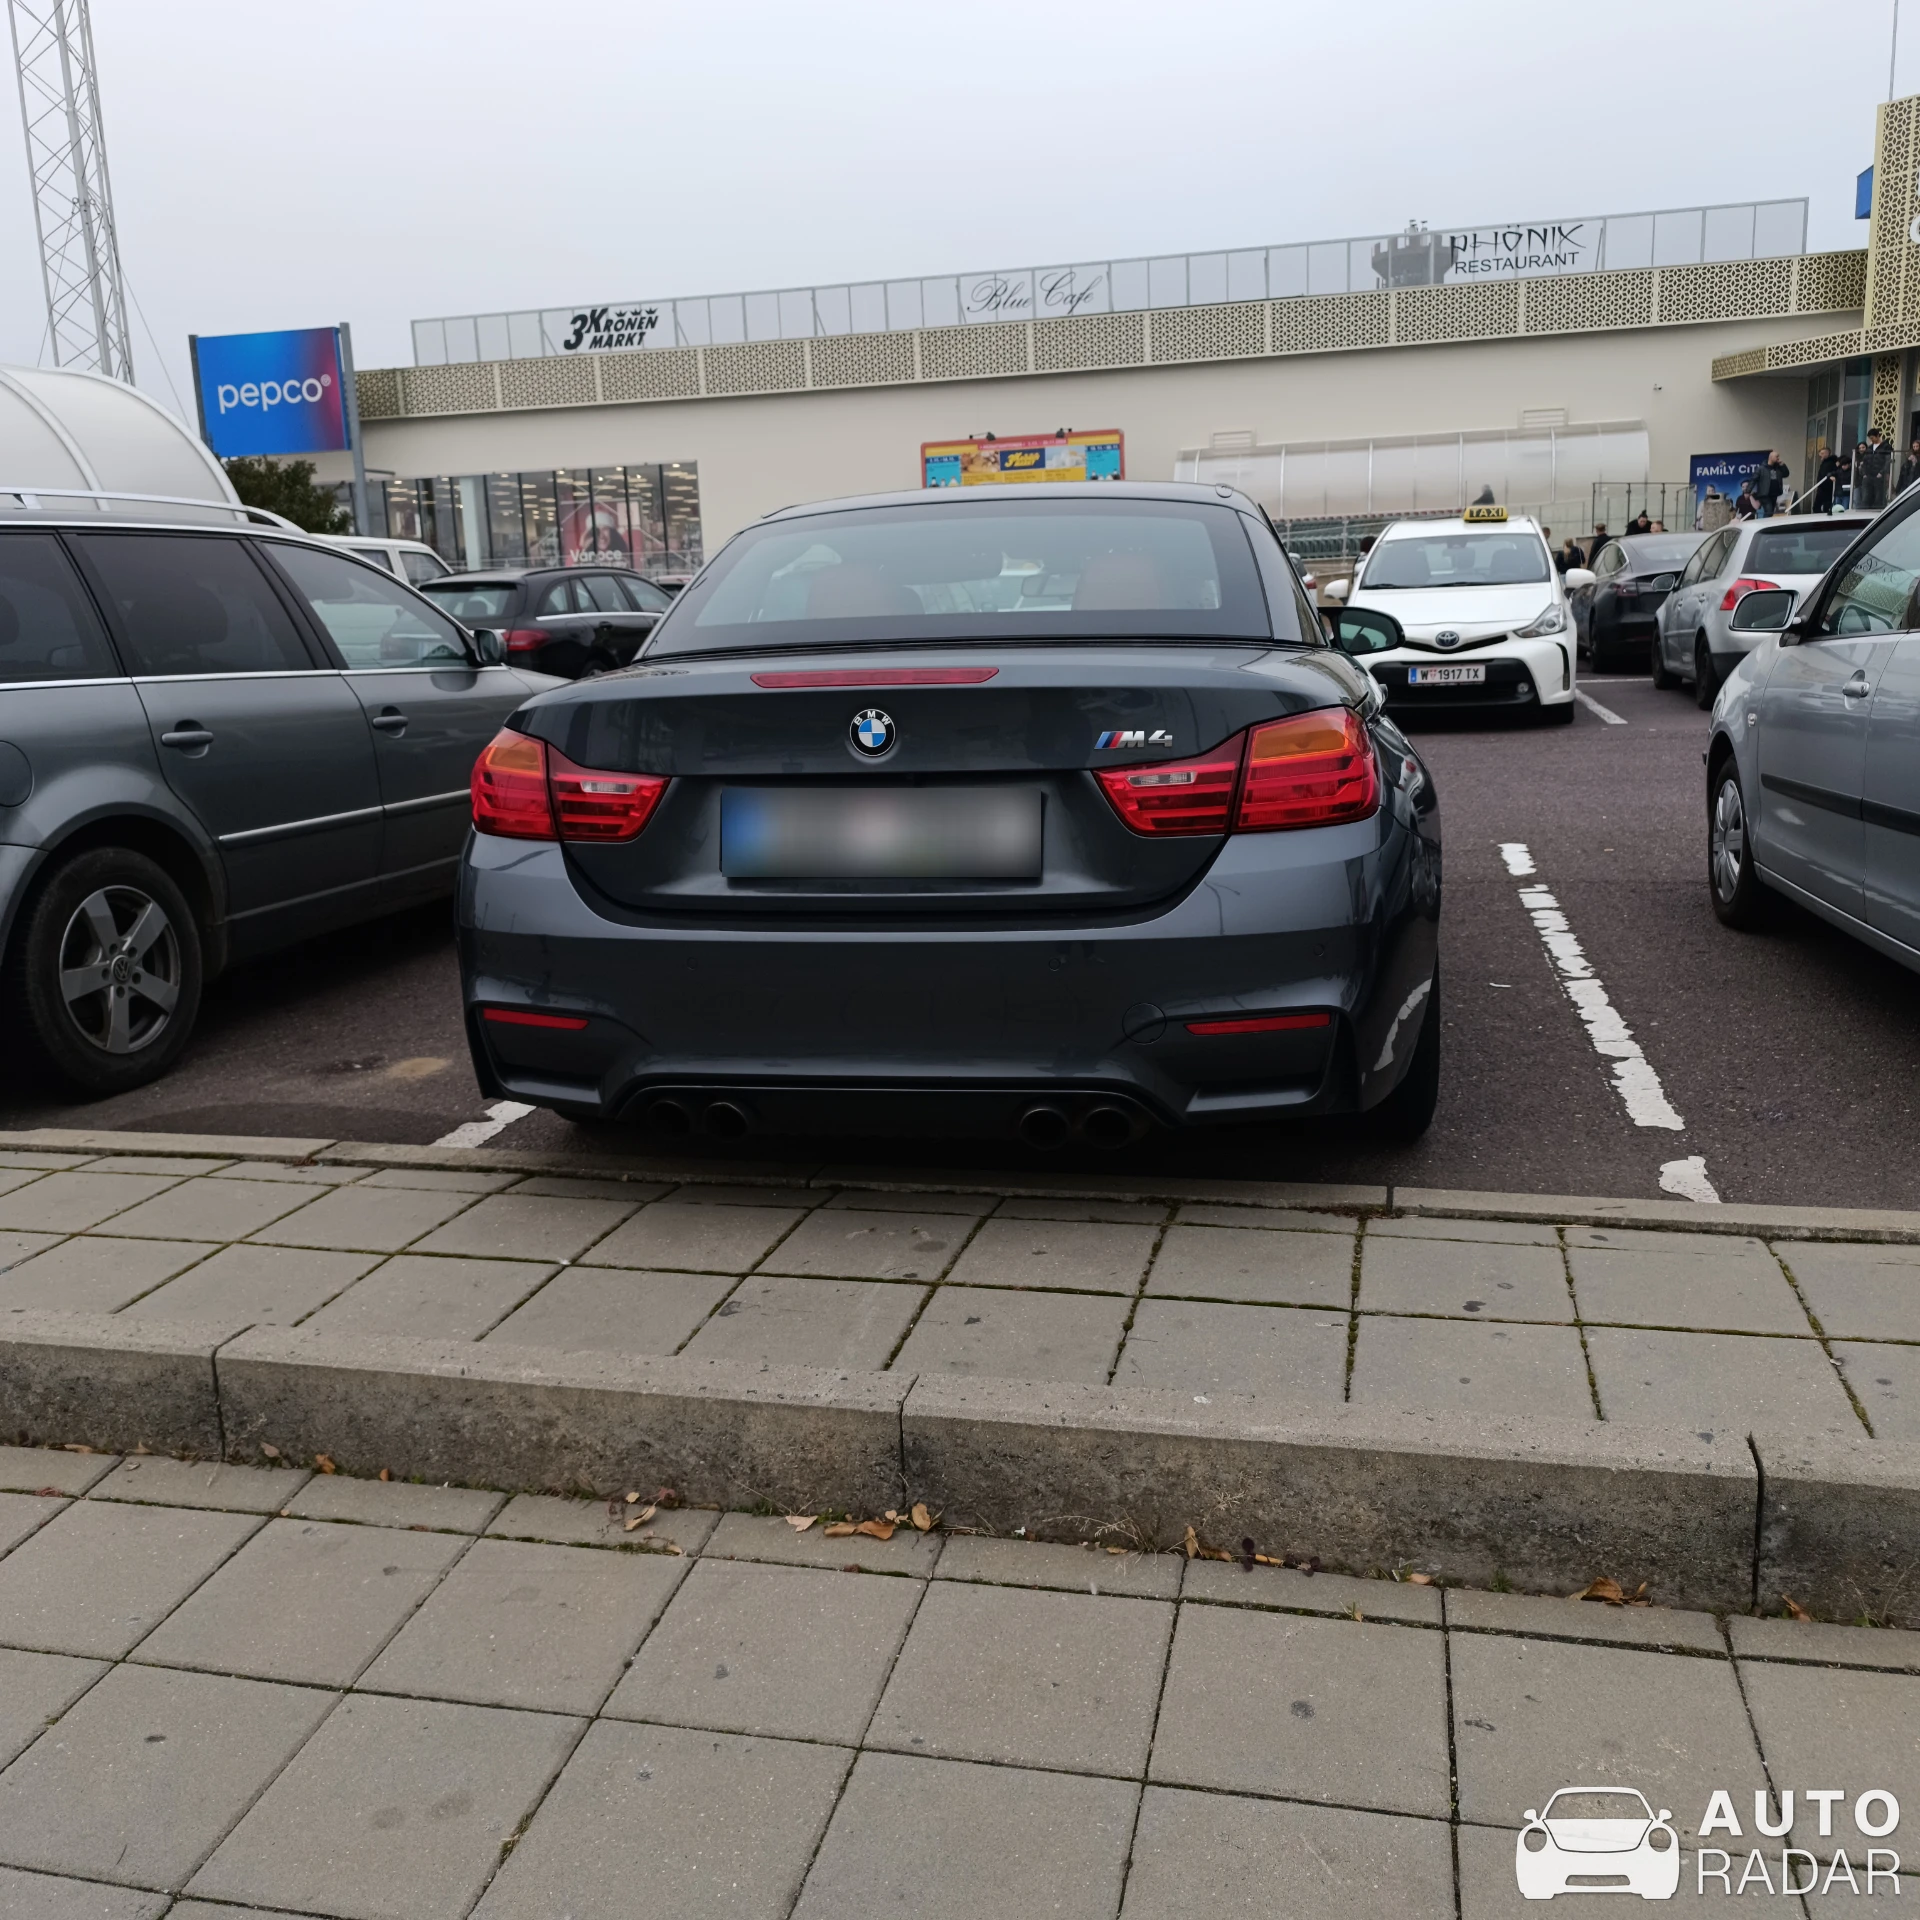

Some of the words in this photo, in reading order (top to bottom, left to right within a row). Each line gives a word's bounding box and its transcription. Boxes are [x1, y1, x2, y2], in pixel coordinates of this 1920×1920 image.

[1450, 224, 1586, 267] PHÖNIX
[1455, 252, 1580, 274] RESTAURANT
[967, 278, 1034, 313] Blue
[1040, 272, 1103, 315] Cafe
[589, 332, 646, 349] MARKT
[1471, 508, 1503, 517] TAXI
[1421, 669, 1429, 681] W
[1438, 668, 1462, 681] 1917
[1465, 668, 1480, 680] TX
[853, 710, 891, 726] BMW
[1116, 730, 1173, 748] M4
